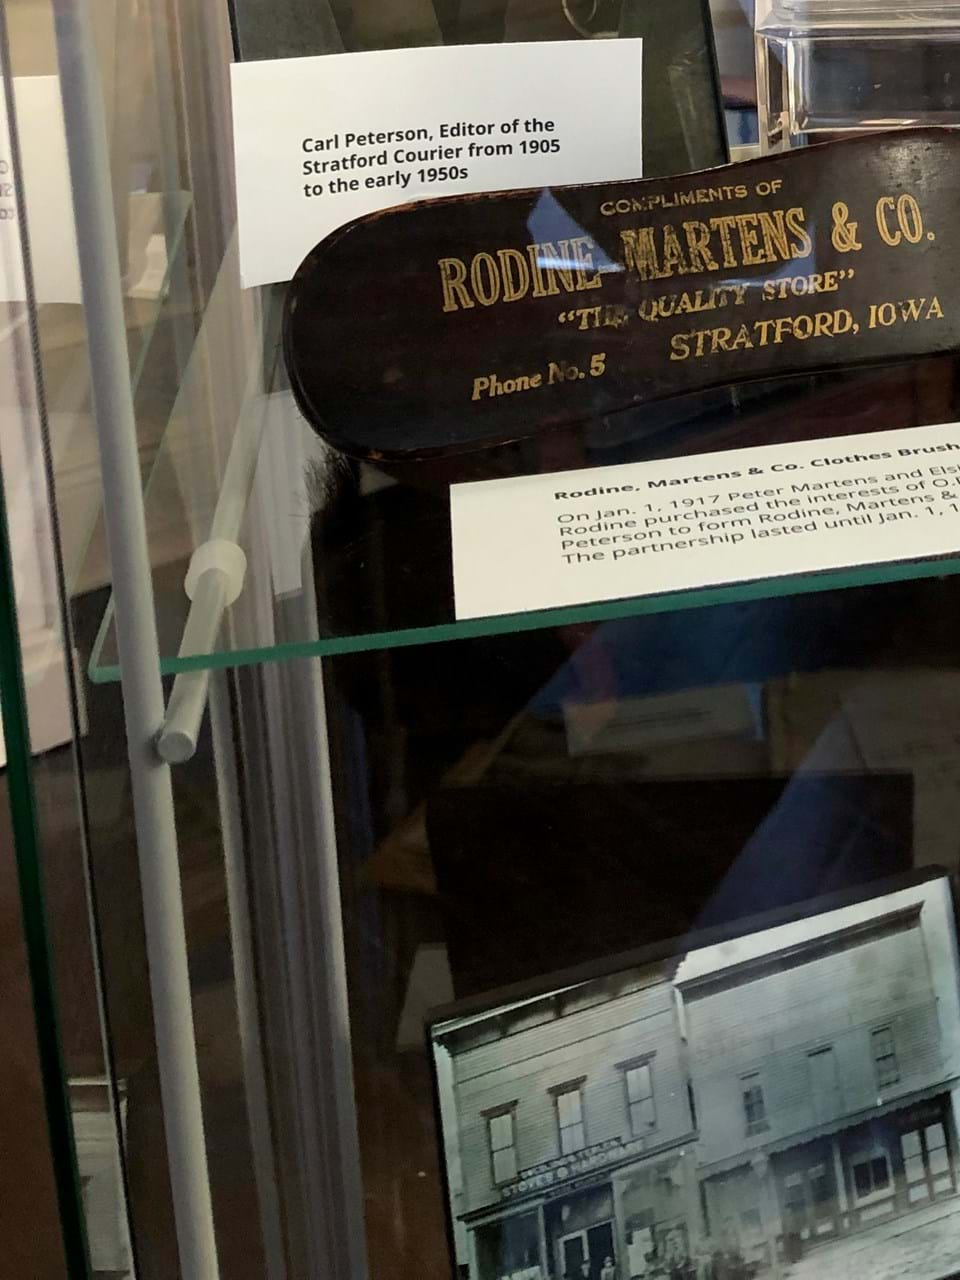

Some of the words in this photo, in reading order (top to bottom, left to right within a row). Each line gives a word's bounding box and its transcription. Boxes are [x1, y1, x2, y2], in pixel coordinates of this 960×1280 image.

[302, 134, 339, 153] Carl
[345, 128, 434, 148] Peterson,
[439, 121, 495, 138] Editor
[500, 118, 520, 134] of
[524, 118, 555, 132] the
[303, 150, 388, 175] Stratford
[393, 144, 463, 164] Courier
[468, 141, 513, 157] from
[519, 138, 561, 155] 1905
[304, 181, 324, 197] to
[328, 178, 359, 194] the
[364, 169, 412, 189] early
[417, 165, 469, 183] 1950s
[600, 185, 749, 216] COMPLIMENTS
[755, 179, 783, 197] OF
[620, 207, 813, 283] MARTENS
[831, 200, 862, 252] &
[875, 192, 936, 247] CO.
[638, 287, 747, 321] QUALITY
[669, 311, 860, 361] STRATFORD,
[868, 295, 944, 328] IOWA
[471, 373, 543, 401] Phone
[589, 352, 607, 377] 5
[554, 483, 641, 501] Rodine,
[647, 469, 742, 489] Martens
[747, 467, 764, 476] &
[770, 463, 805, 472] Co.
[810, 449, 892, 467] Clothes
[897, 442, 960, 457] Brush
[557, 513, 589, 524] On
[594, 507, 637, 521] Jan.
[643, 503, 662, 513] 1,
[670, 495, 721, 509] 1917
[728, 487, 785, 501] Peter
[791, 475, 879, 494] Martens
[884, 469, 924, 482] and
[559, 519, 637, 536] Rodine
[644, 502, 760, 527] purchased
[766, 497, 801, 510] the
[807, 485, 900, 504] interests
[905, 480, 926, 491] of
[561, 531, 662, 550] Peterson
[668, 525, 692, 537] to
[697, 517, 752, 532] form
[758, 505, 841, 524] Rodine,
[846, 494, 936, 513] Martens
[940, 490, 959, 500] &
[561, 550, 605, 564] The
[612, 532, 745, 561] partnership
[751, 521, 818, 540] lasted
[824, 513, 873, 530] until
[878, 508, 919, 525] Jan.
[925, 505, 944, 517] 1,
